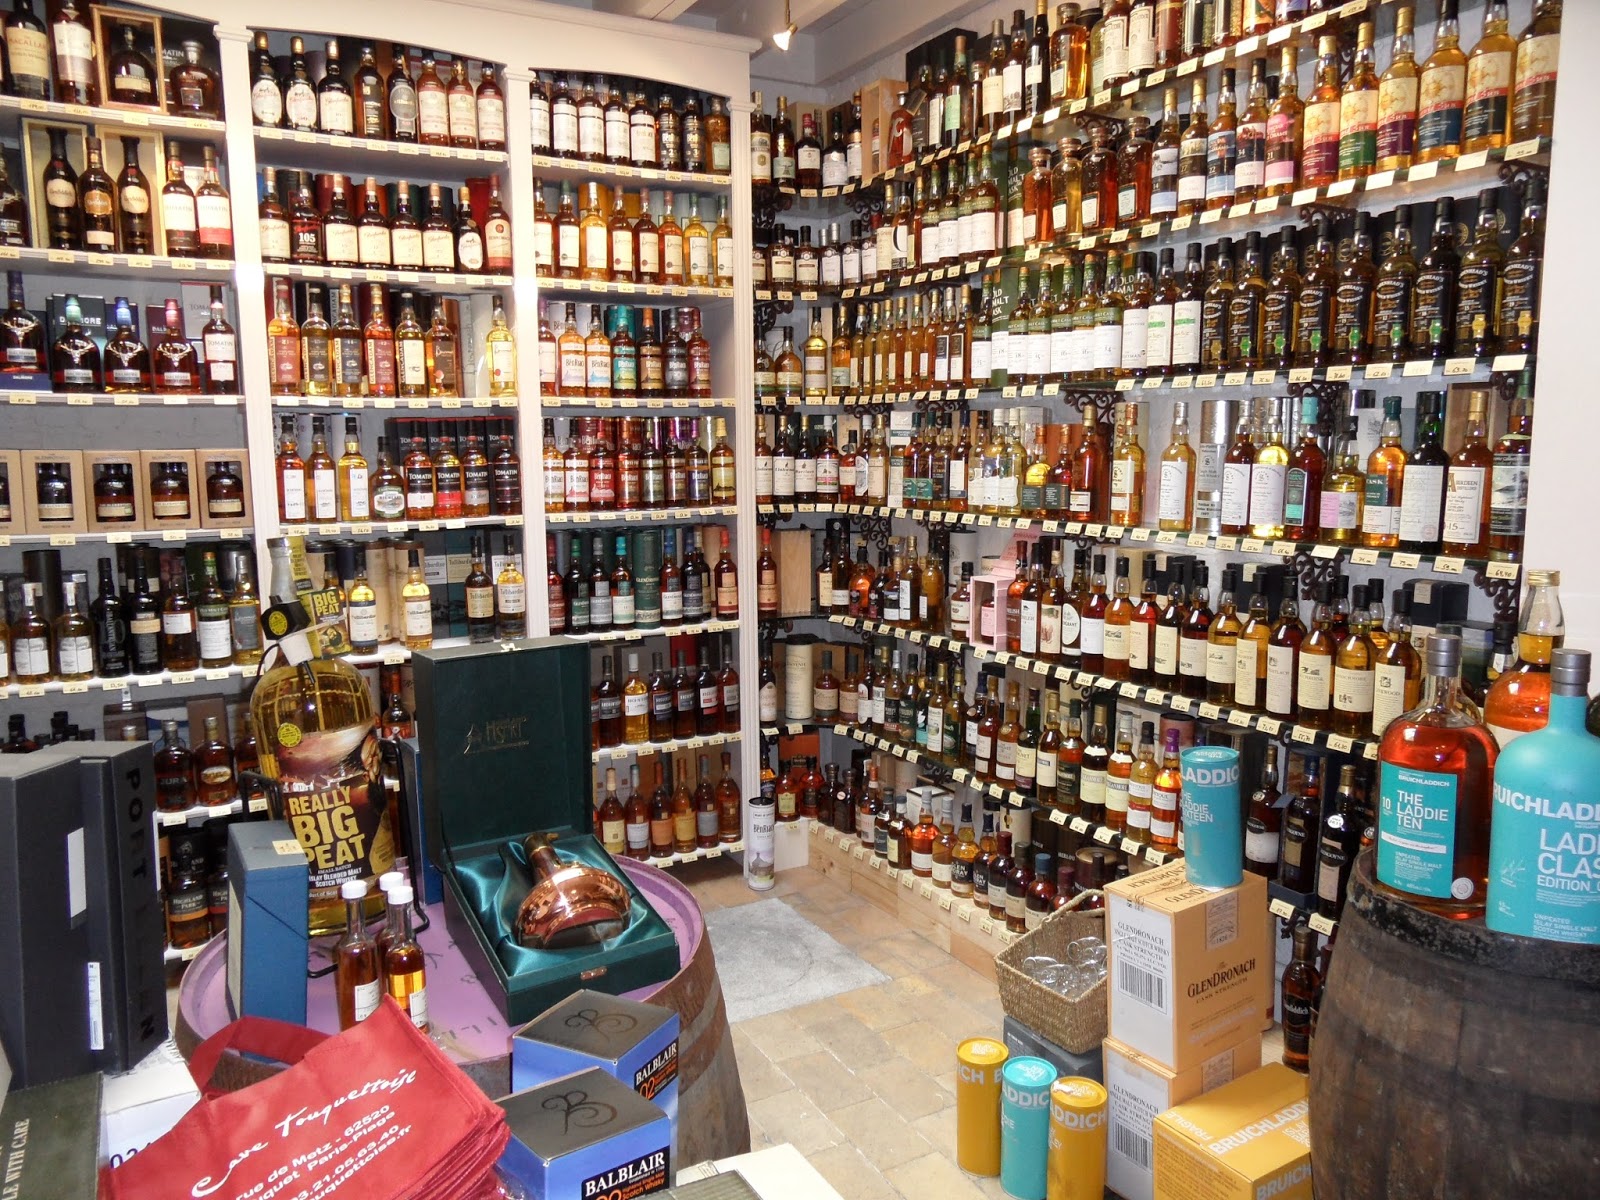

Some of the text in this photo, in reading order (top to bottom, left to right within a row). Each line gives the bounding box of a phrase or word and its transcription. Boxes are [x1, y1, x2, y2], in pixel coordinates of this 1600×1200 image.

[299, 233, 315, 242] 105
[408, 471, 432, 480] TOMATIN
[495, 469, 517, 477] TOMATIN
[313, 591, 337, 606] BIG
[316, 603, 340, 616] PEAT
[160, 776, 187, 786] JURA
[1398, 774, 1450, 787] BRUICHLADDICH
[289, 786, 352, 816] REALLY
[1382, 796, 1391, 810] 10
[1397, 790, 1424, 807] THE
[1397, 802, 1449, 822] LADDIE
[1397, 813, 1423, 831] TEN
[292, 806, 359, 848] BIG
[303, 834, 366, 869] PEAT
[1540, 828, 1600, 856] LAD
[324, 871, 348, 880] BLENDED
[348, 867, 362, 877] MALT
[315, 880, 336, 888] SCOTCH
[173, 894, 203, 906] HIGHLAND
[1117, 921, 1165, 947] GLENDRONACH
[1134, 945, 1164, 963] STRENGTH
[1187, 958, 1256, 999] GLENDRONACH
[1214, 976, 1249, 996] STRENGTH
[635, 1042, 677, 1087] BALBLAIR
[1113, 1083, 1160, 1114] GLENDRONACH
[14, 1117, 31, 1150] CARE
[190, 1067, 418, 1199] Cave Touquettoise
[1163, 1110, 1214, 1142] FRAGILE
[307, 1111, 396, 1172] Paris-Plage
[236, 1176, 266, 1200] rue
[267, 1164, 290, 1184] de
[292, 1143, 333, 1168] Metz
[344, 1104, 390, 1137] 62520
[5, 1149, 26, 1185] WITH
[585, 1151, 665, 1198] BALBLAIR
[645, 1177, 665, 1192] Whisky
